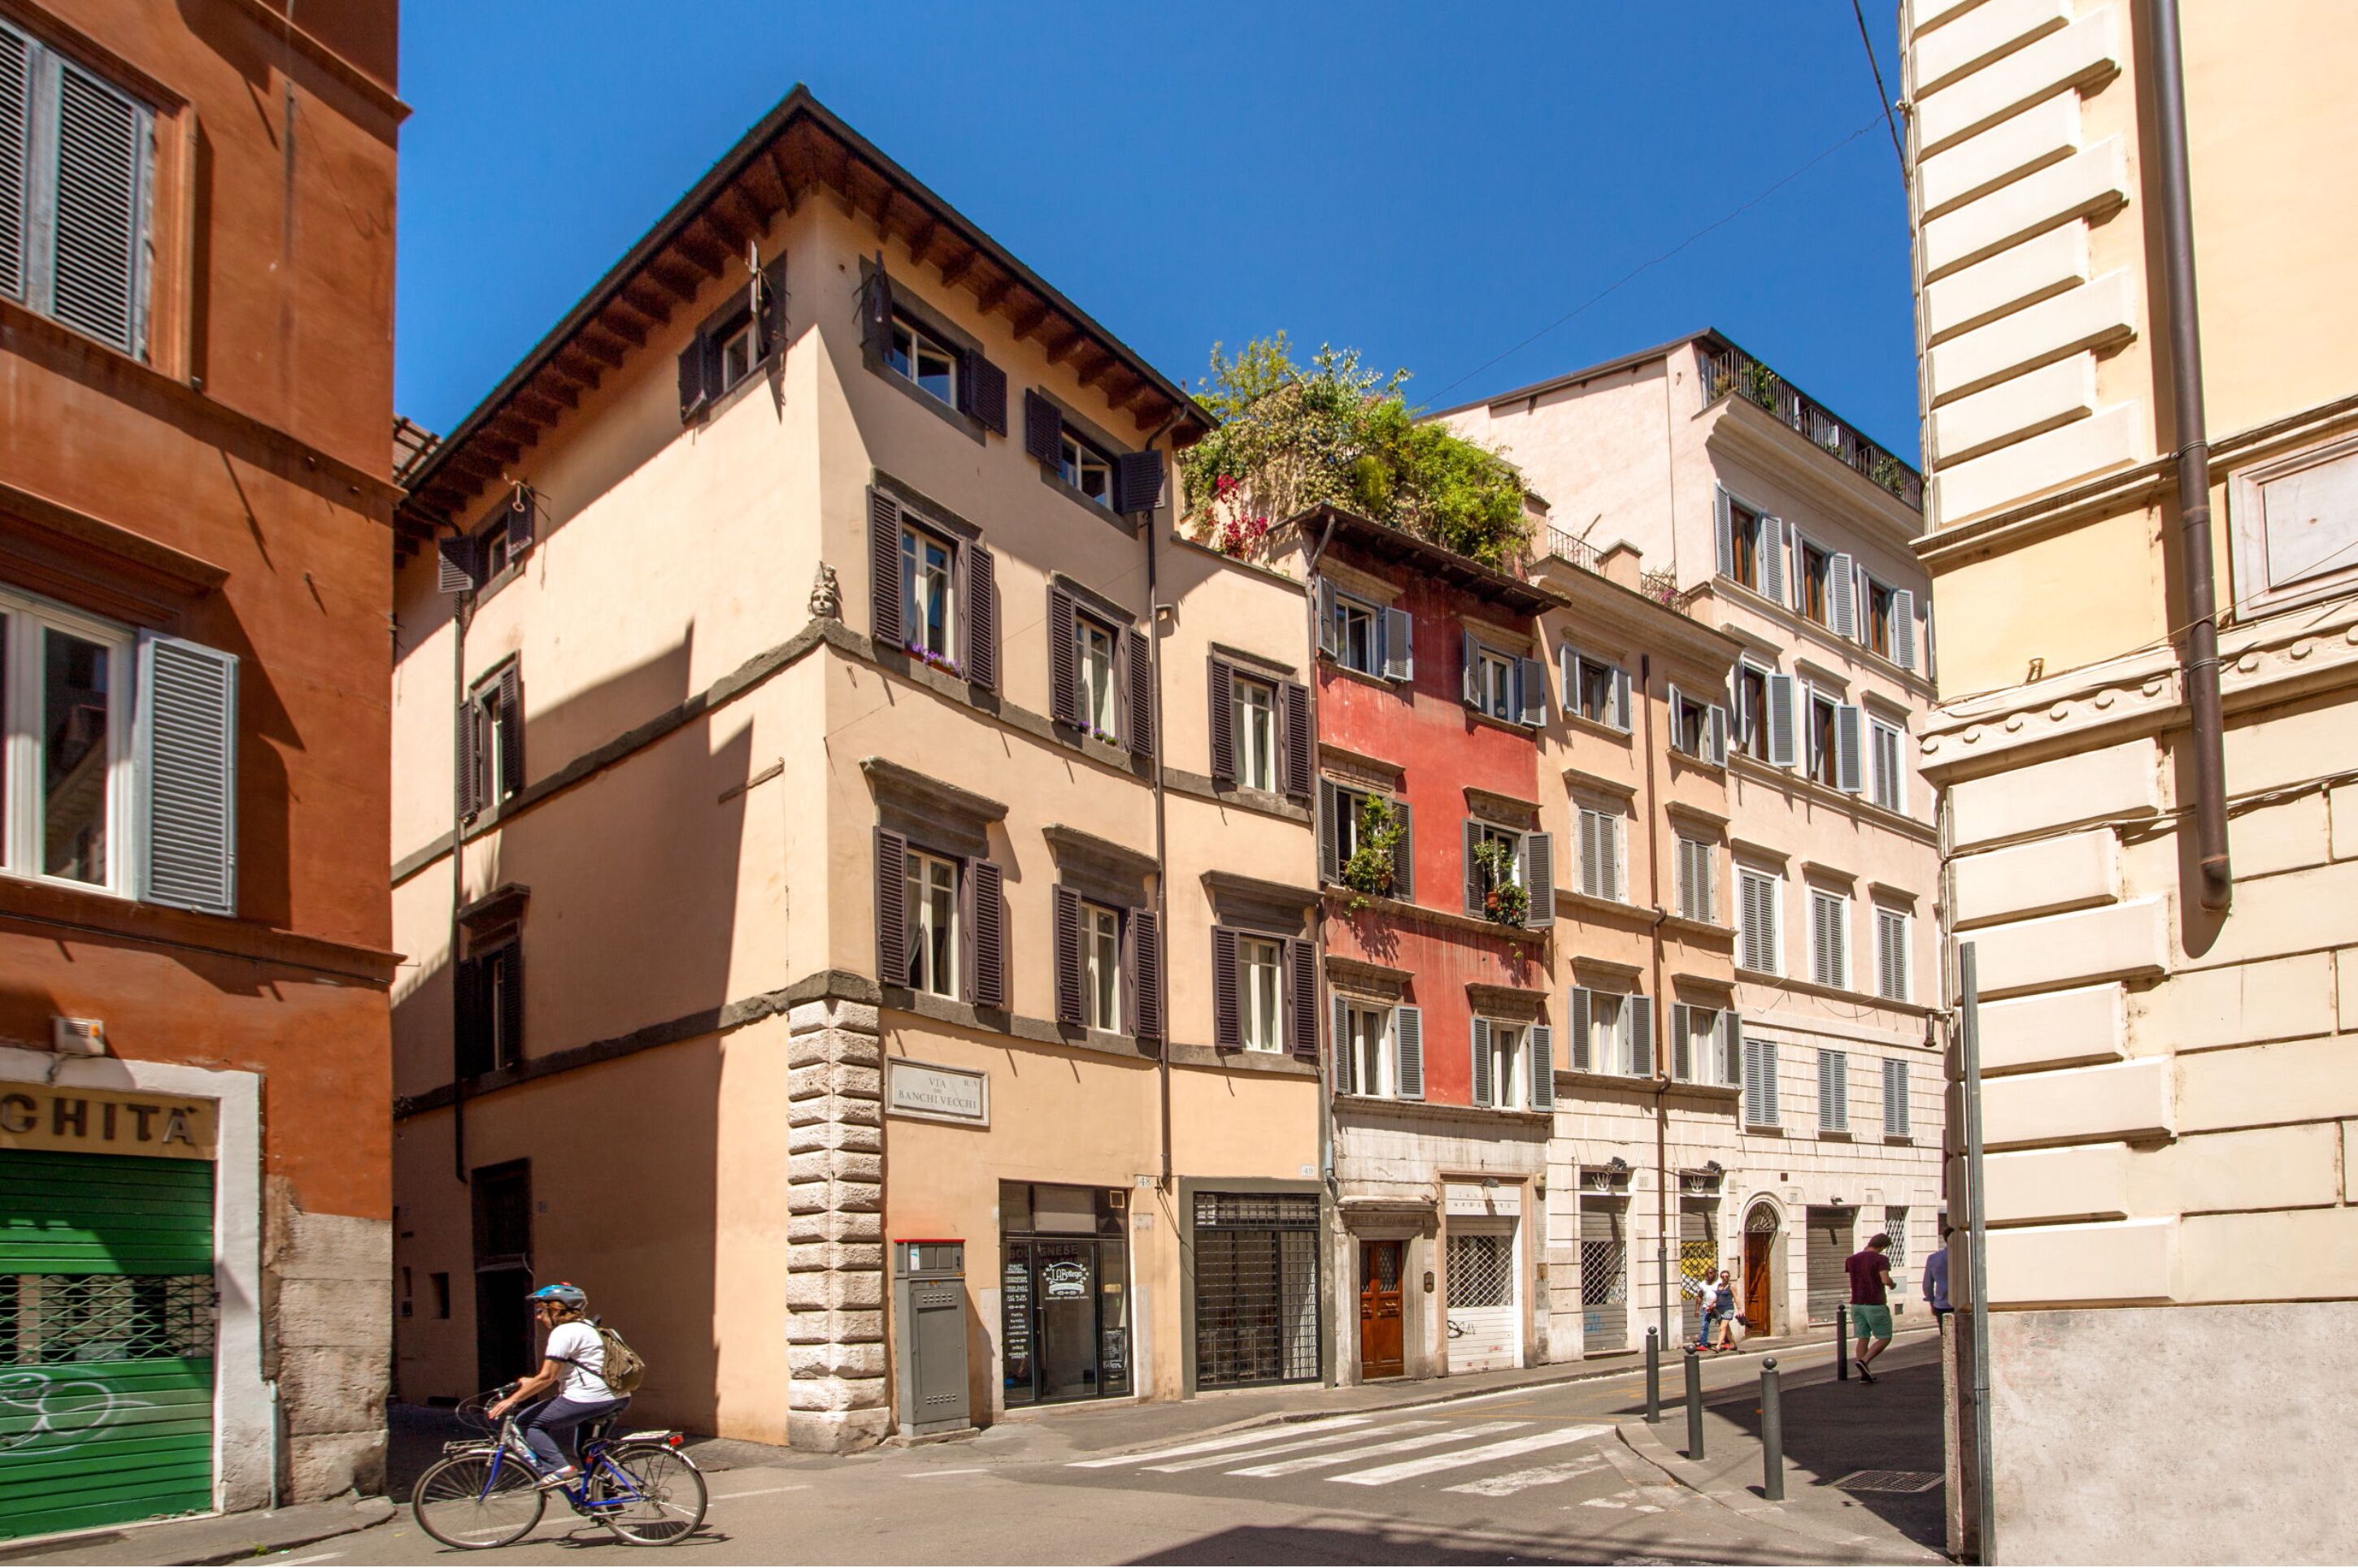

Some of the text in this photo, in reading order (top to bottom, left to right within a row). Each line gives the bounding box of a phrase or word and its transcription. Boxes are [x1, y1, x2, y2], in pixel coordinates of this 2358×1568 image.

[929, 1077, 946, 1088] VIA
[898, 1090, 977, 1109] BANCHI VECCHI
[1139, 1177, 1151, 1186] 48
